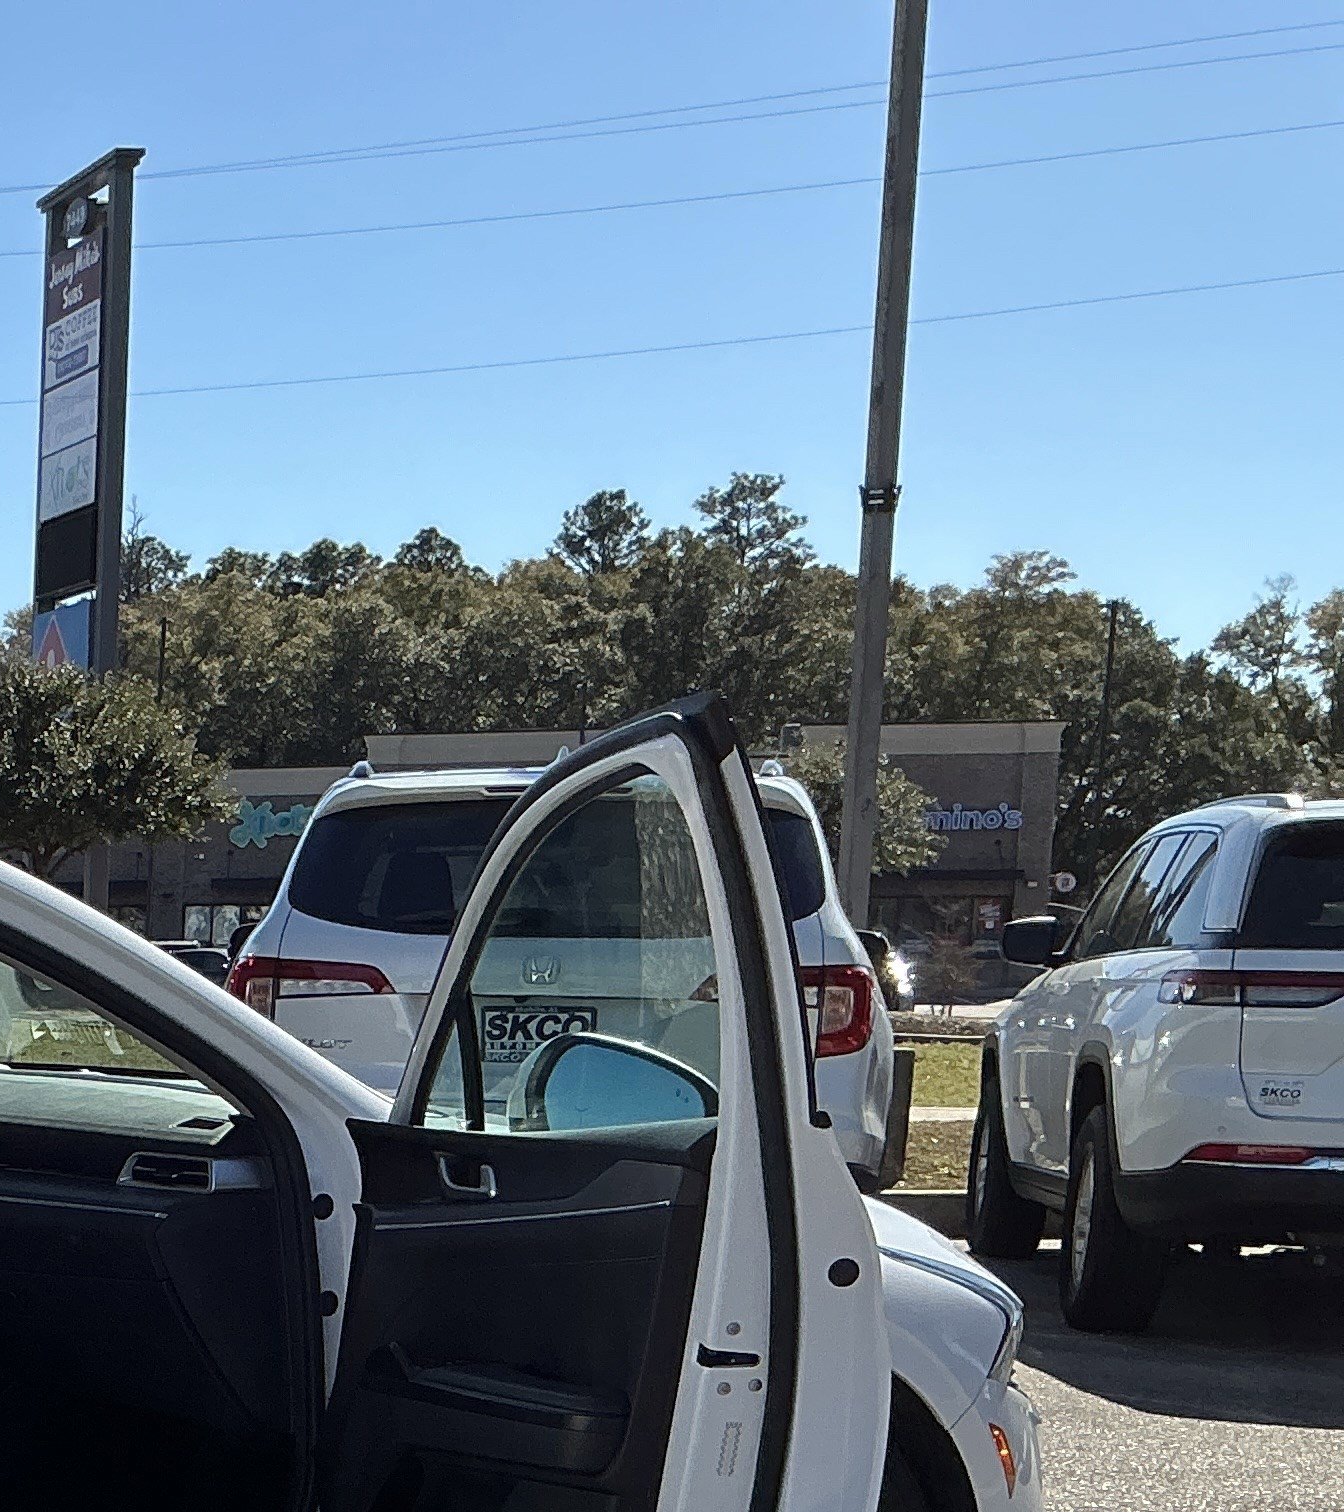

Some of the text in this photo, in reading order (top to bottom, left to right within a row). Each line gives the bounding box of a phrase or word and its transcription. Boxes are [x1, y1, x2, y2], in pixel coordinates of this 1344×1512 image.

[923, 802, 1023, 830] mino's
[485, 1014, 590, 1041] SKCO
[1260, 1087, 1301, 1099] SKCO
